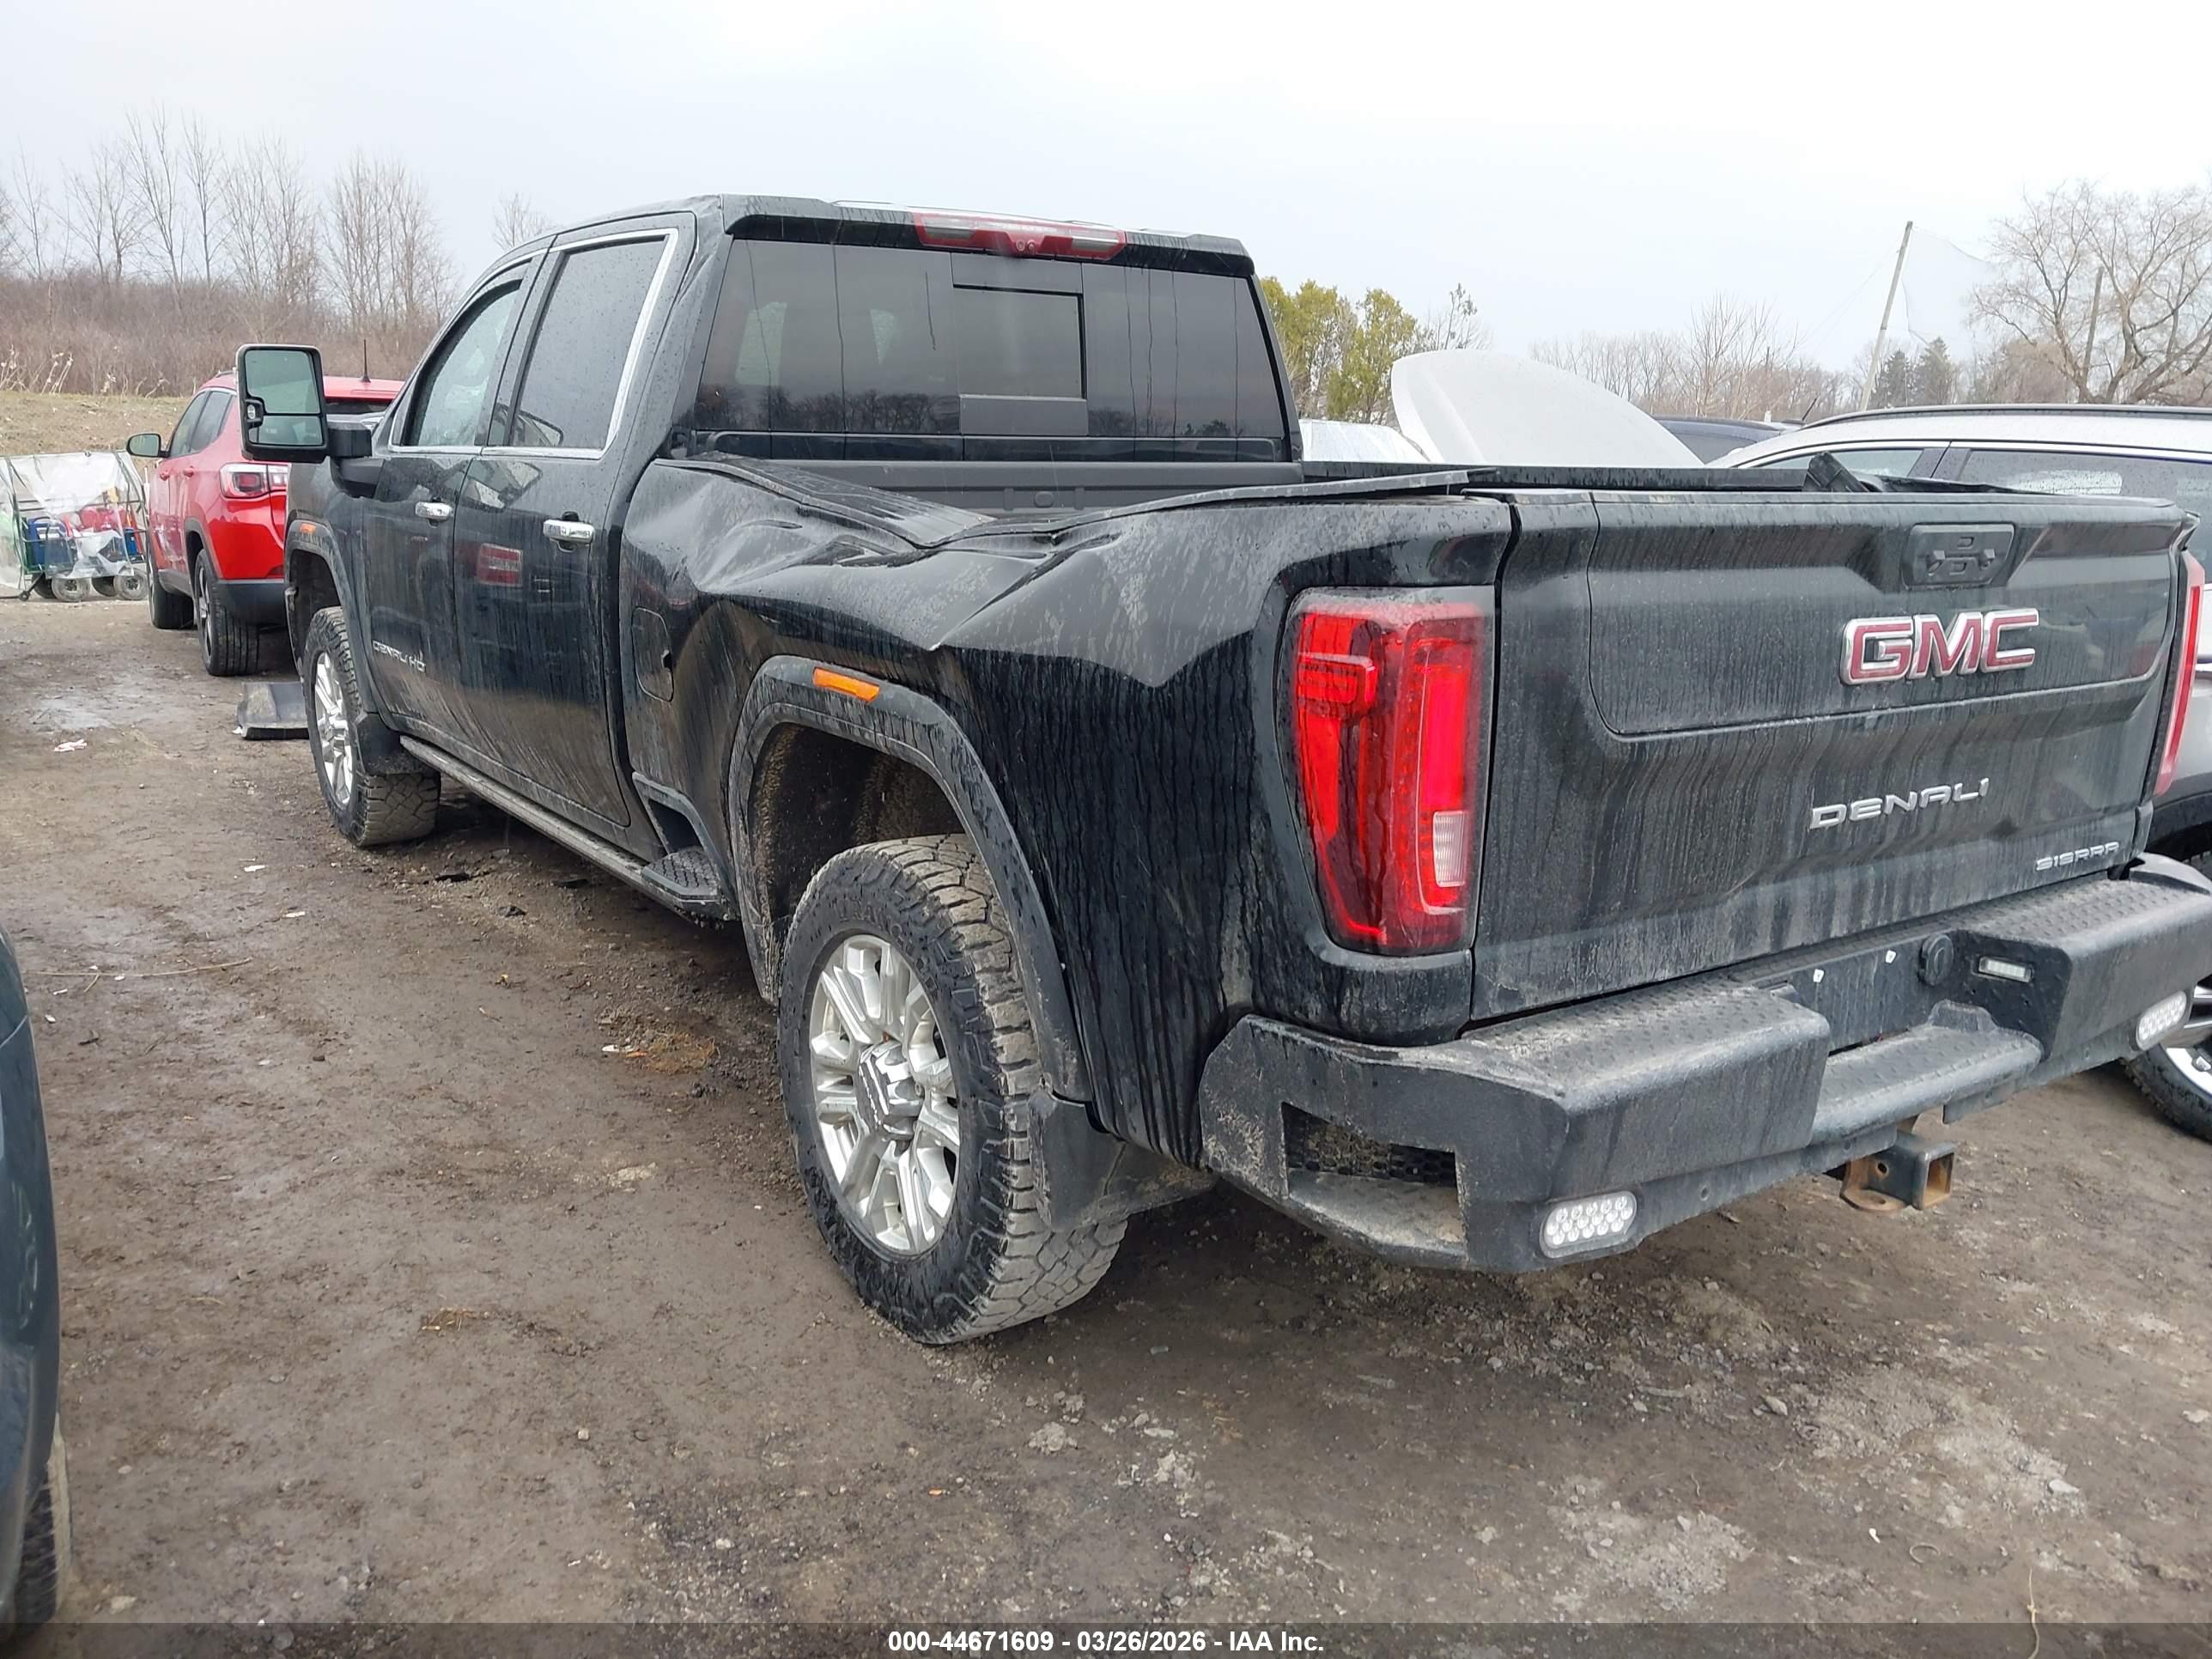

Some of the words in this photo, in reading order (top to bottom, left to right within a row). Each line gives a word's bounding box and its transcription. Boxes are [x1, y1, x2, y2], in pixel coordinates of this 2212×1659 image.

[1841, 609, 2039, 686] GMC
[1809, 777, 1990, 830] DENALI
[2035, 841, 2120, 872] SIERRA
